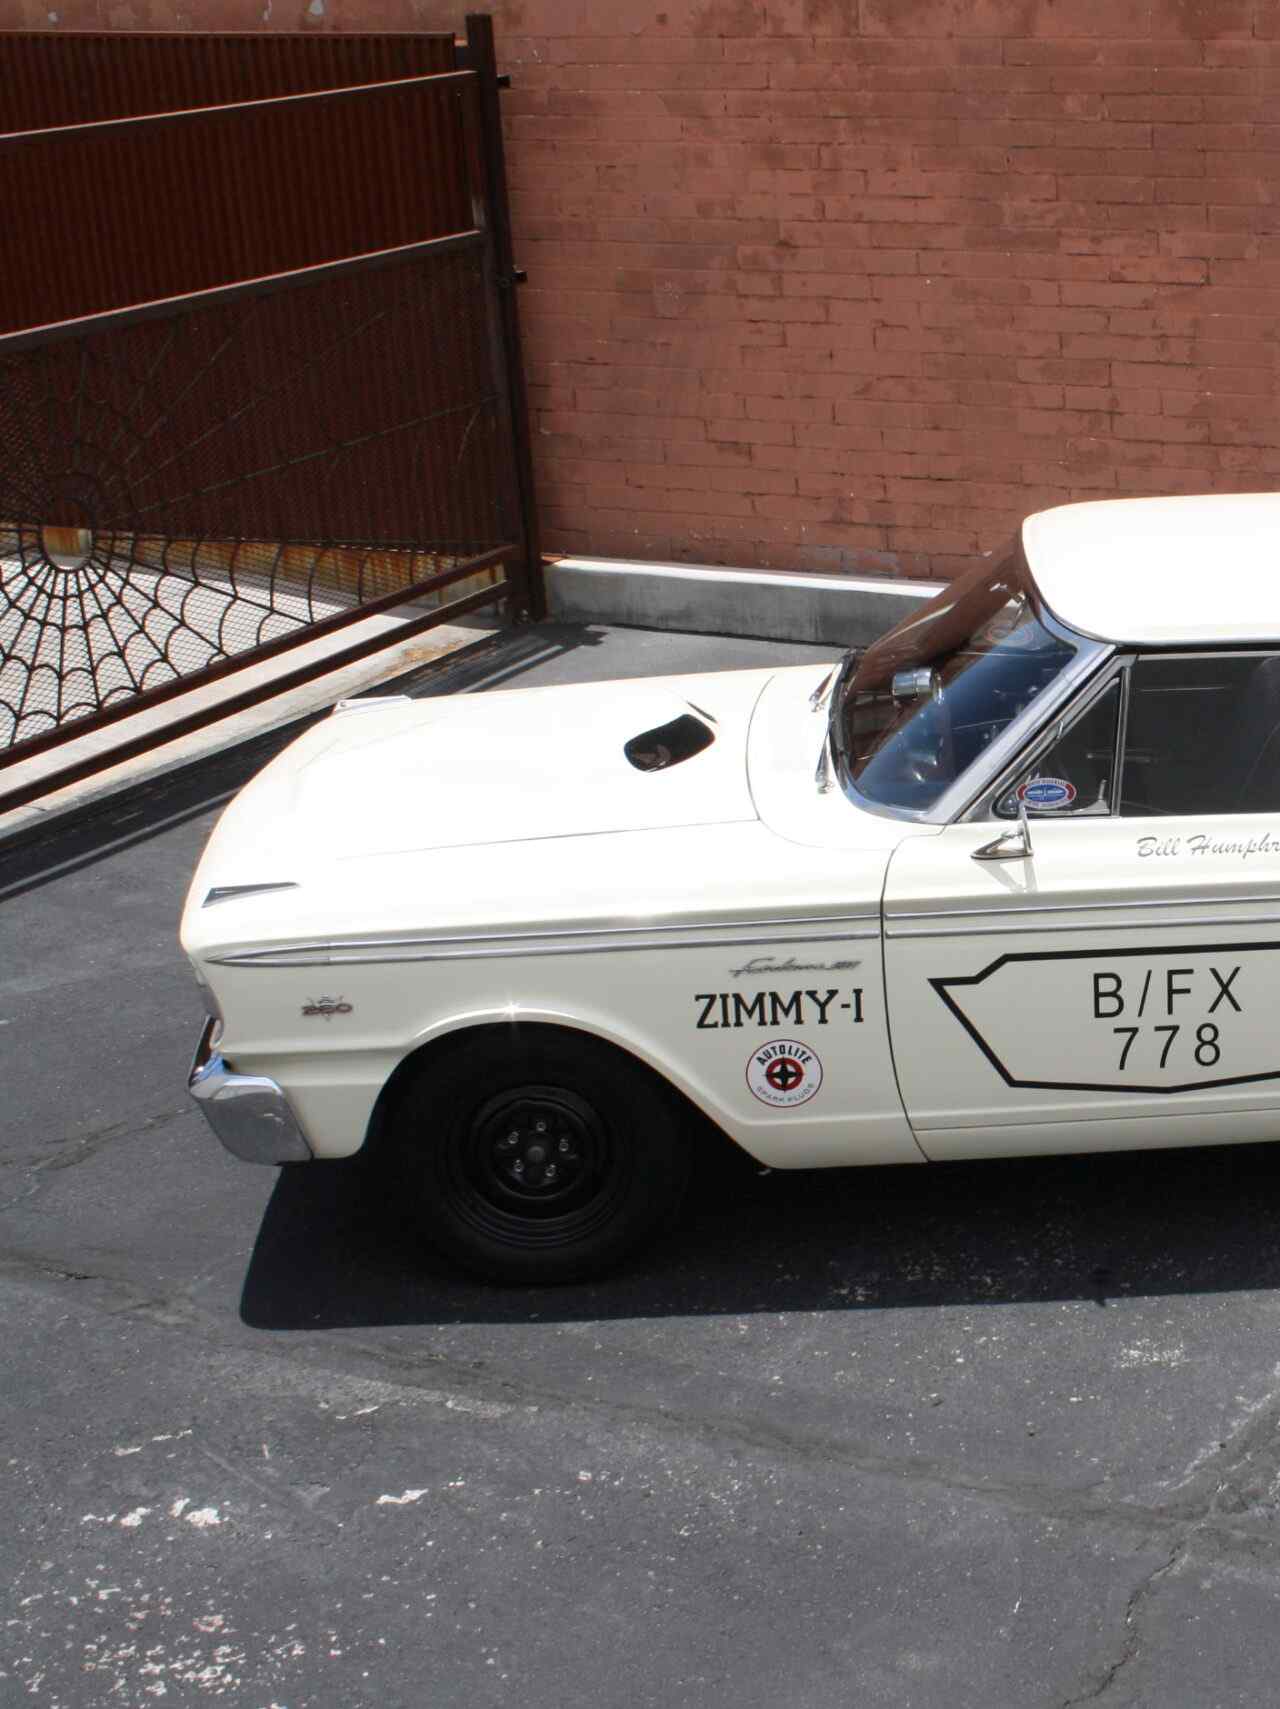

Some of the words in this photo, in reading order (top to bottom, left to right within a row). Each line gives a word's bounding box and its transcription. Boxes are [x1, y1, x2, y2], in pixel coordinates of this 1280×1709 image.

[1136, 836, 1180, 858] Bill
[694, 988, 864, 1029] ZIMMY-I
[1093, 966, 1242, 1019] B/FX
[756, 1044, 812, 1066] AUTOLITE
[1113, 1022, 1221, 1070] 778
